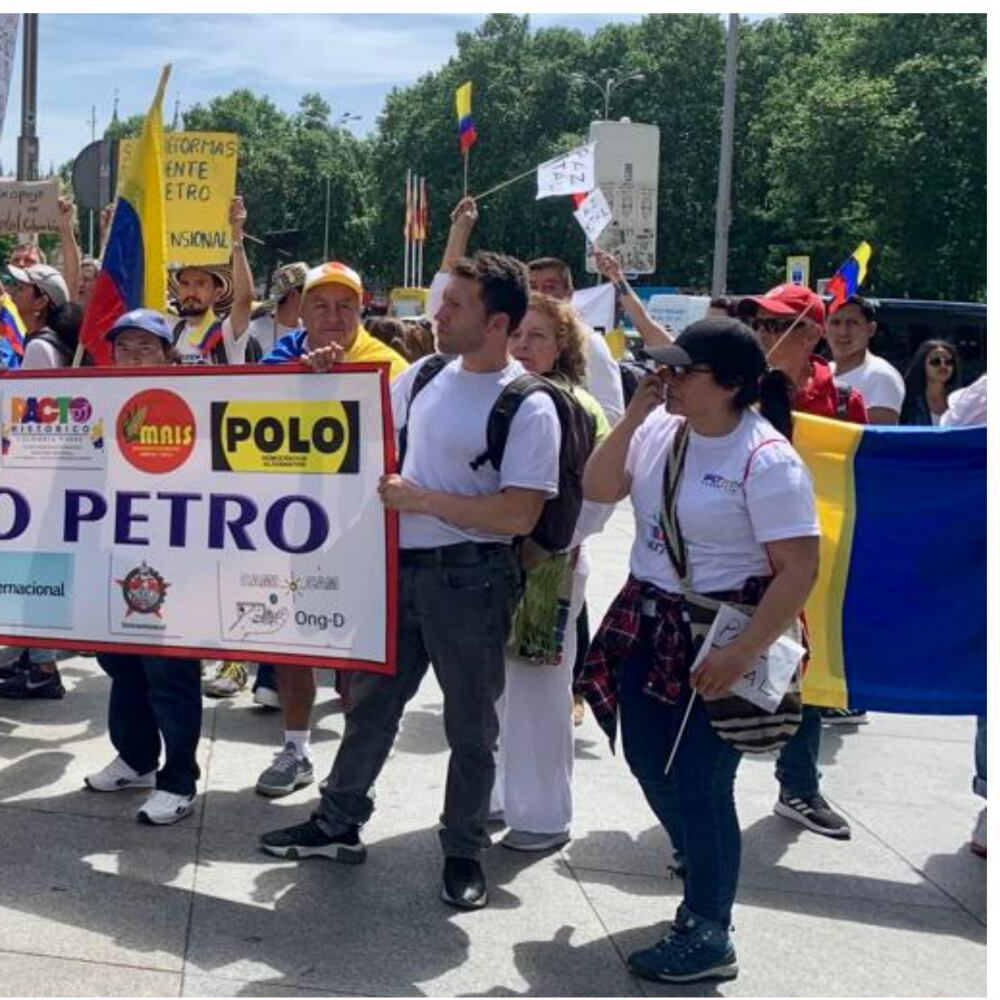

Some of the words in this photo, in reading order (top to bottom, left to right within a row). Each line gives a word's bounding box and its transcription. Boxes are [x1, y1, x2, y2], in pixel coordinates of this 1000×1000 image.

[166, 231, 228, 249] NSIONAL
[227, 416, 344, 454] POLO
[63, 488, 330, 555] PETRO
[294, 610, 346, 631] Ong-D
